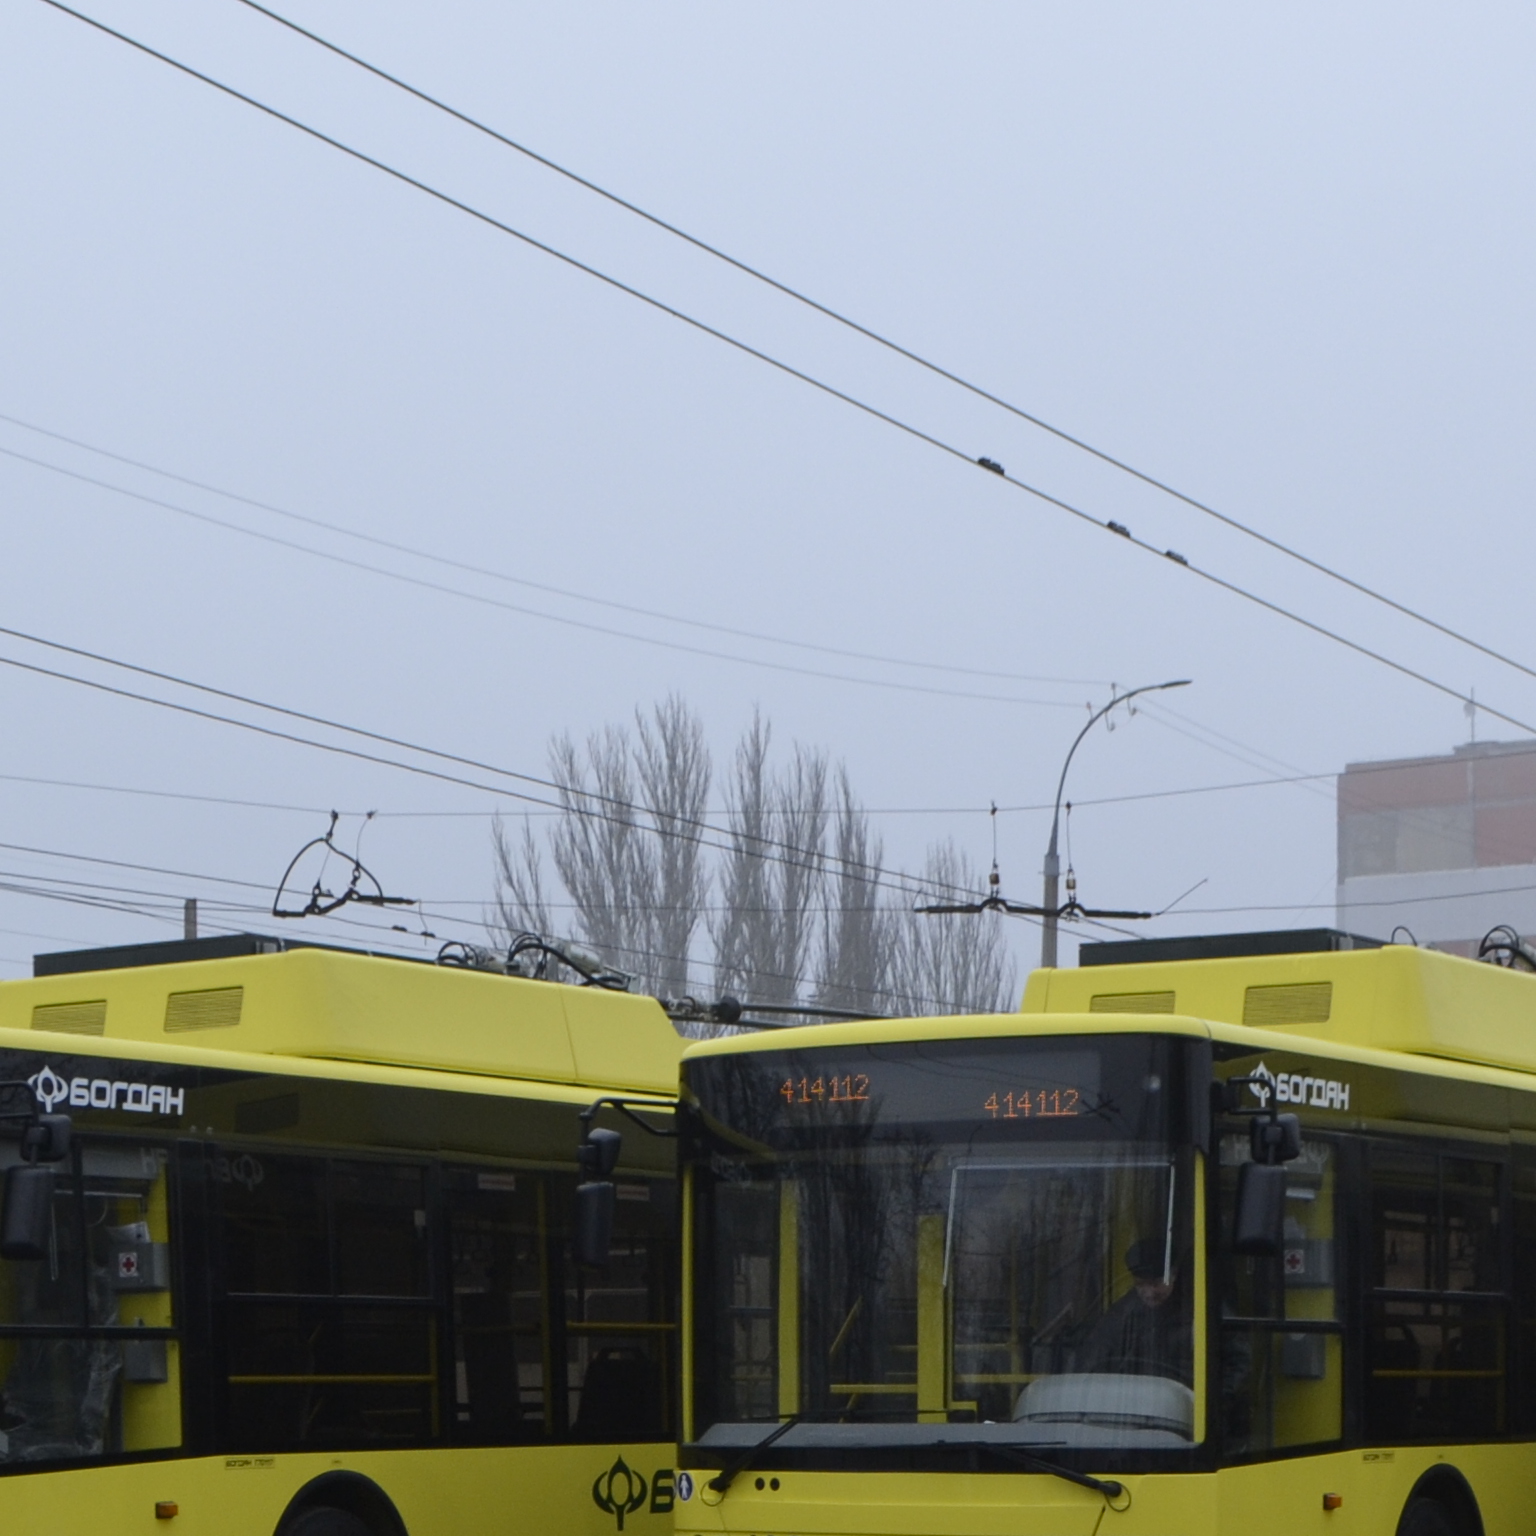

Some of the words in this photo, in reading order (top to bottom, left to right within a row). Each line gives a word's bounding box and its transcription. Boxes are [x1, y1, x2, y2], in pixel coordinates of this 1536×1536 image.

[69, 1077, 184, 1116] БОГДАН
[780, 1074, 870, 1103] 414112
[985, 1089, 1079, 1118] 414112
[1276, 1073, 1350, 1110] БОГДАН
